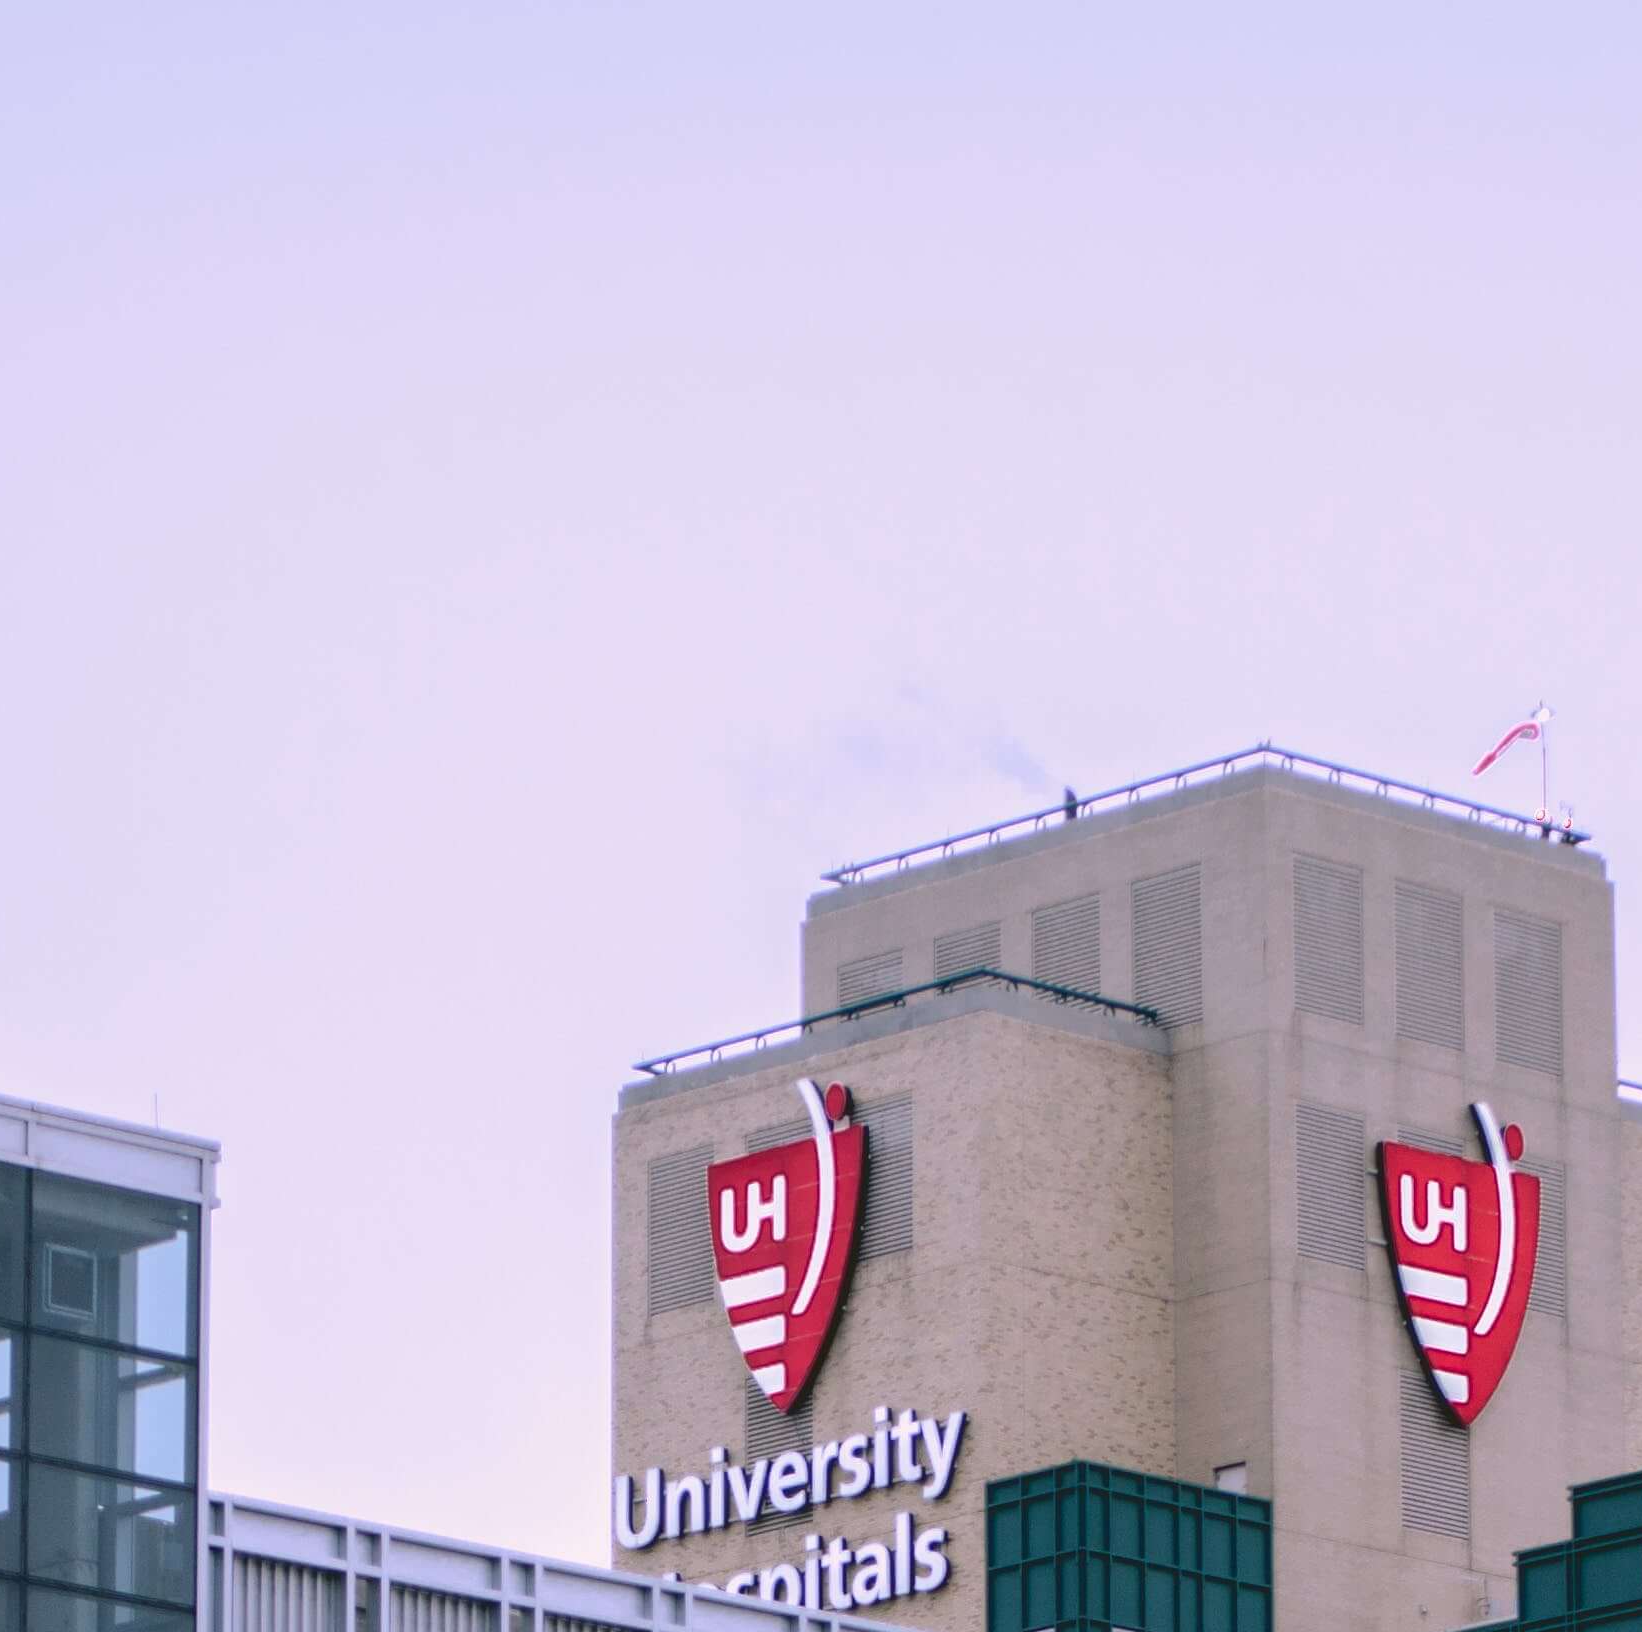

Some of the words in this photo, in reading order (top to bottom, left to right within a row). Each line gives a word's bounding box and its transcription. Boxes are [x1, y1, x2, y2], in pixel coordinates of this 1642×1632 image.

[720, 1173, 787, 1253] UH
[1400, 1173, 1467, 1252] UH
[614, 1406, 966, 1550] University
[662, 1512, 949, 1610] pitals
